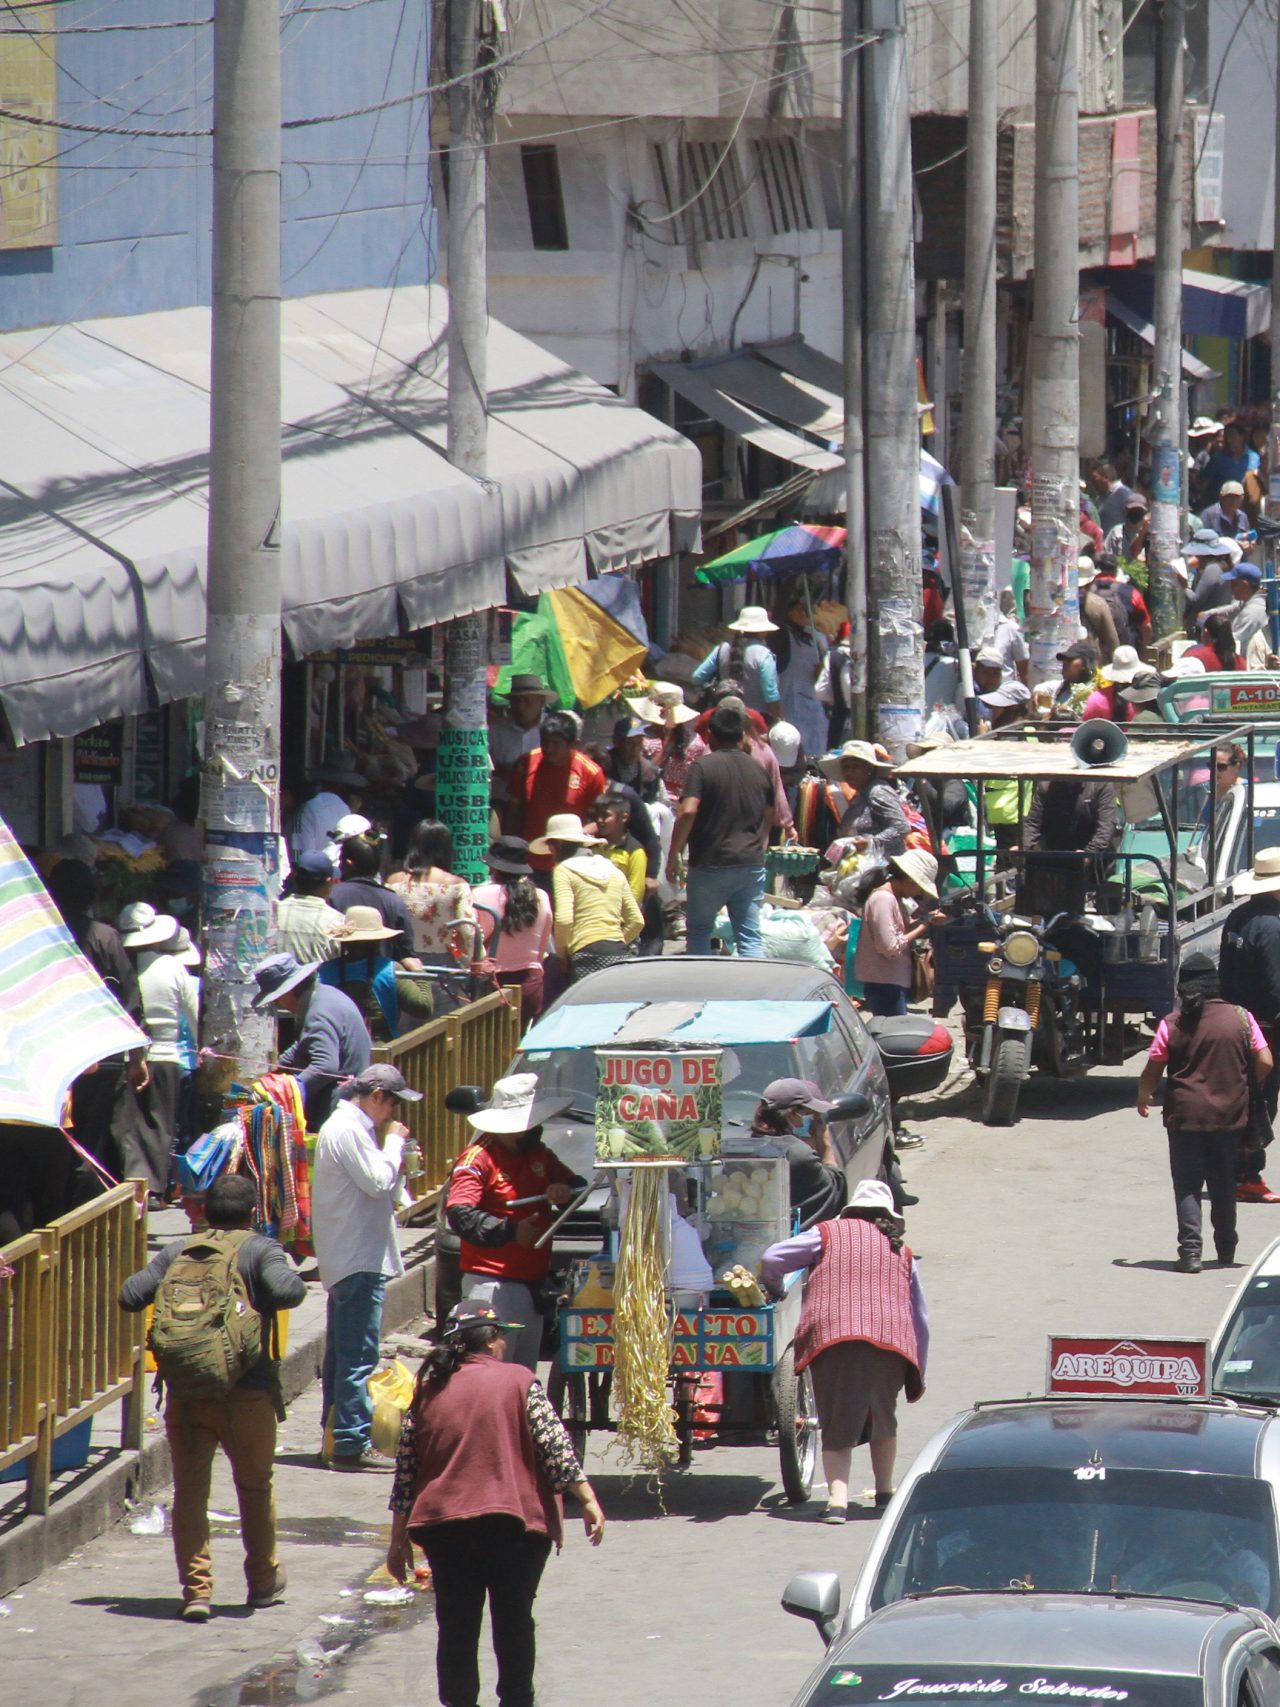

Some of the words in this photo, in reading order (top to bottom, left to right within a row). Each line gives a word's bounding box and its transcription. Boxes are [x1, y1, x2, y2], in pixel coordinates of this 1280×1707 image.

[438, 731, 486, 746] MUSICA
[452, 747, 469, 755] EN
[439, 754, 487, 768] USB
[438, 770, 487, 784] PELICULAS
[452, 785, 467, 793] EN
[439, 795, 486, 807] USB
[438, 809, 486, 824] MUSICA
[602, 1058, 672, 1086] JUGO
[682, 1058, 717, 1085] DE
[619, 1088, 698, 1121] CAÑA
[1054, 1355, 1199, 1385] AREQUIPA
[1177, 1385, 1198, 1395] VIP
[1073, 1467, 1106, 1480] 101
[878, 1679, 1008, 1700] Jesucristo
[1019, 1678, 1128, 1700] Salvador
